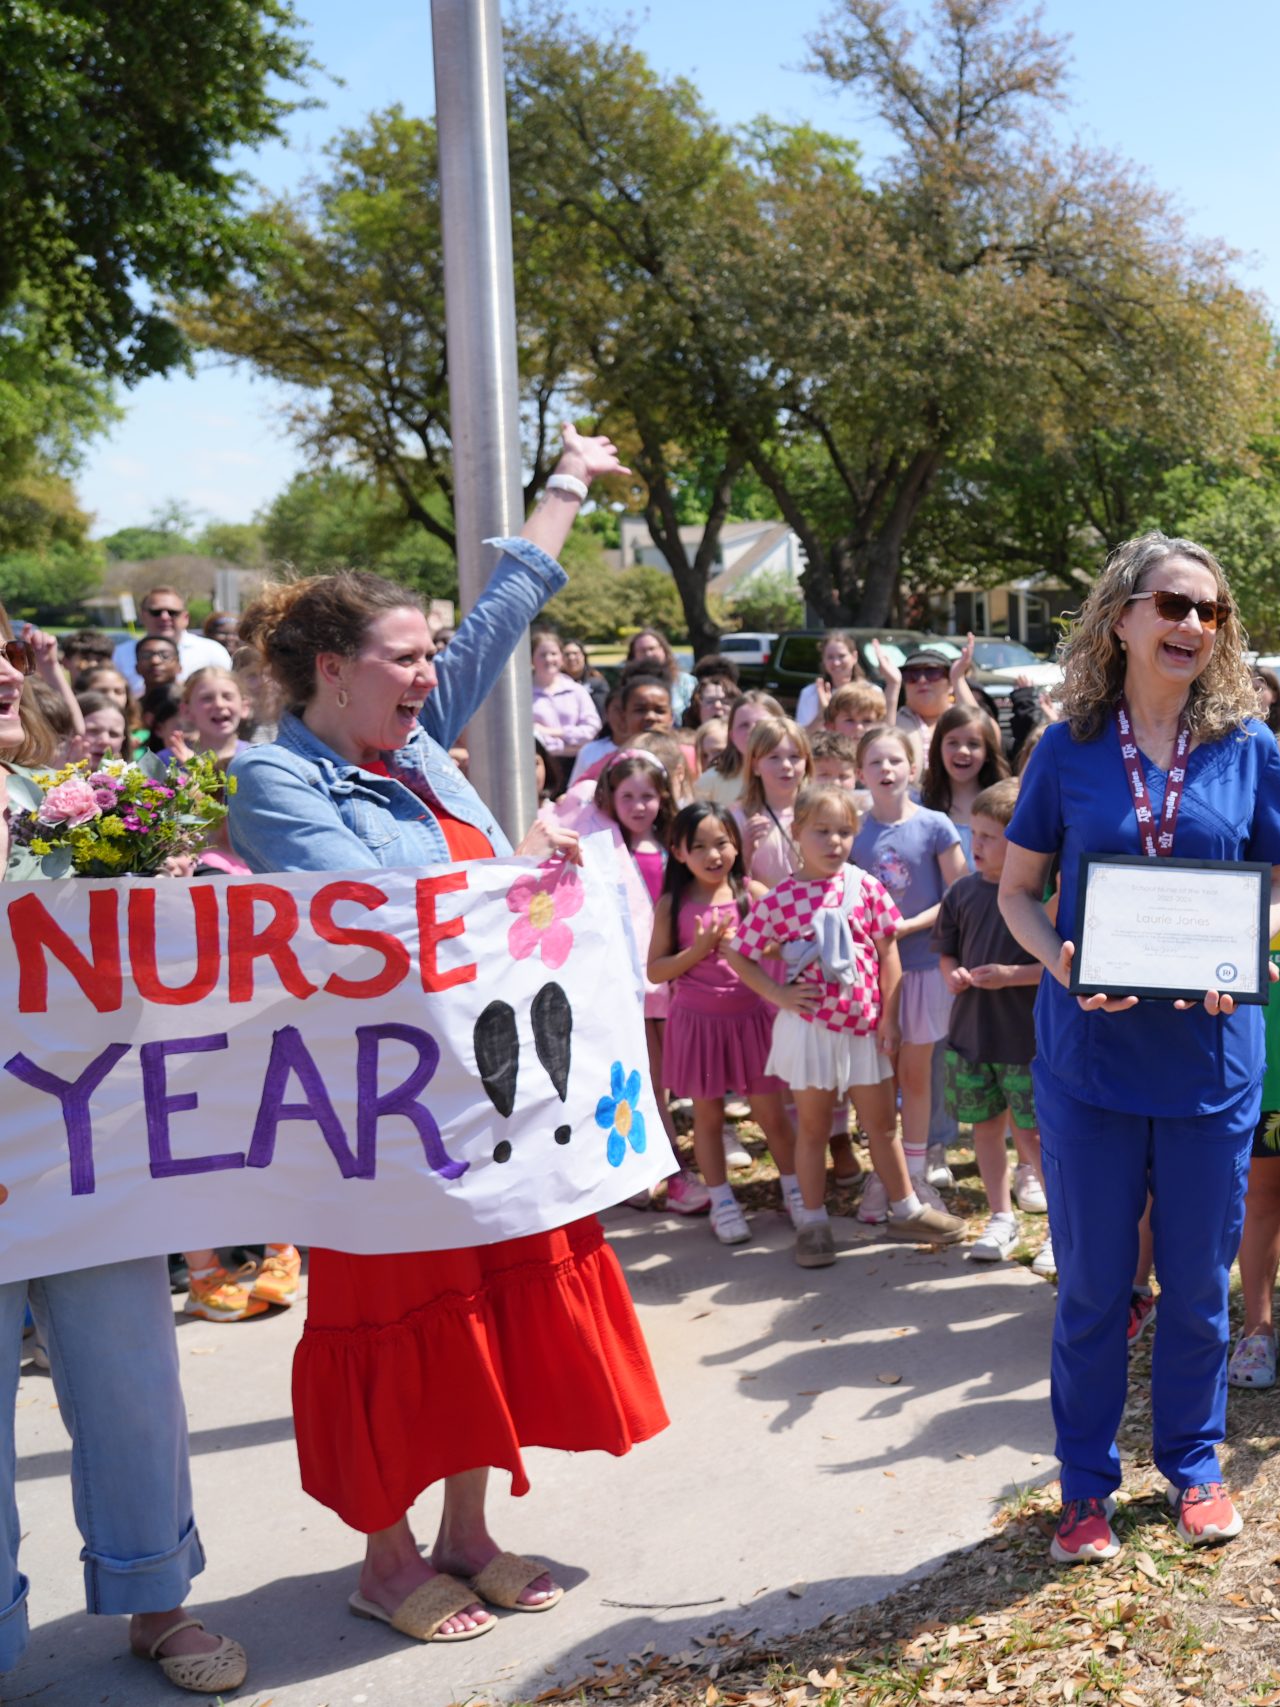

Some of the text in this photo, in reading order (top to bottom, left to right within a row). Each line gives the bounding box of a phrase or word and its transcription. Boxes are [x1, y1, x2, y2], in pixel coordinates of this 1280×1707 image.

[1132, 771, 1144, 797] Aggies
[1165, 791, 1178, 819] Aggies
[1136, 912, 1210, 927] Laurie Jones
[8, 871, 477, 1013] NURSE
